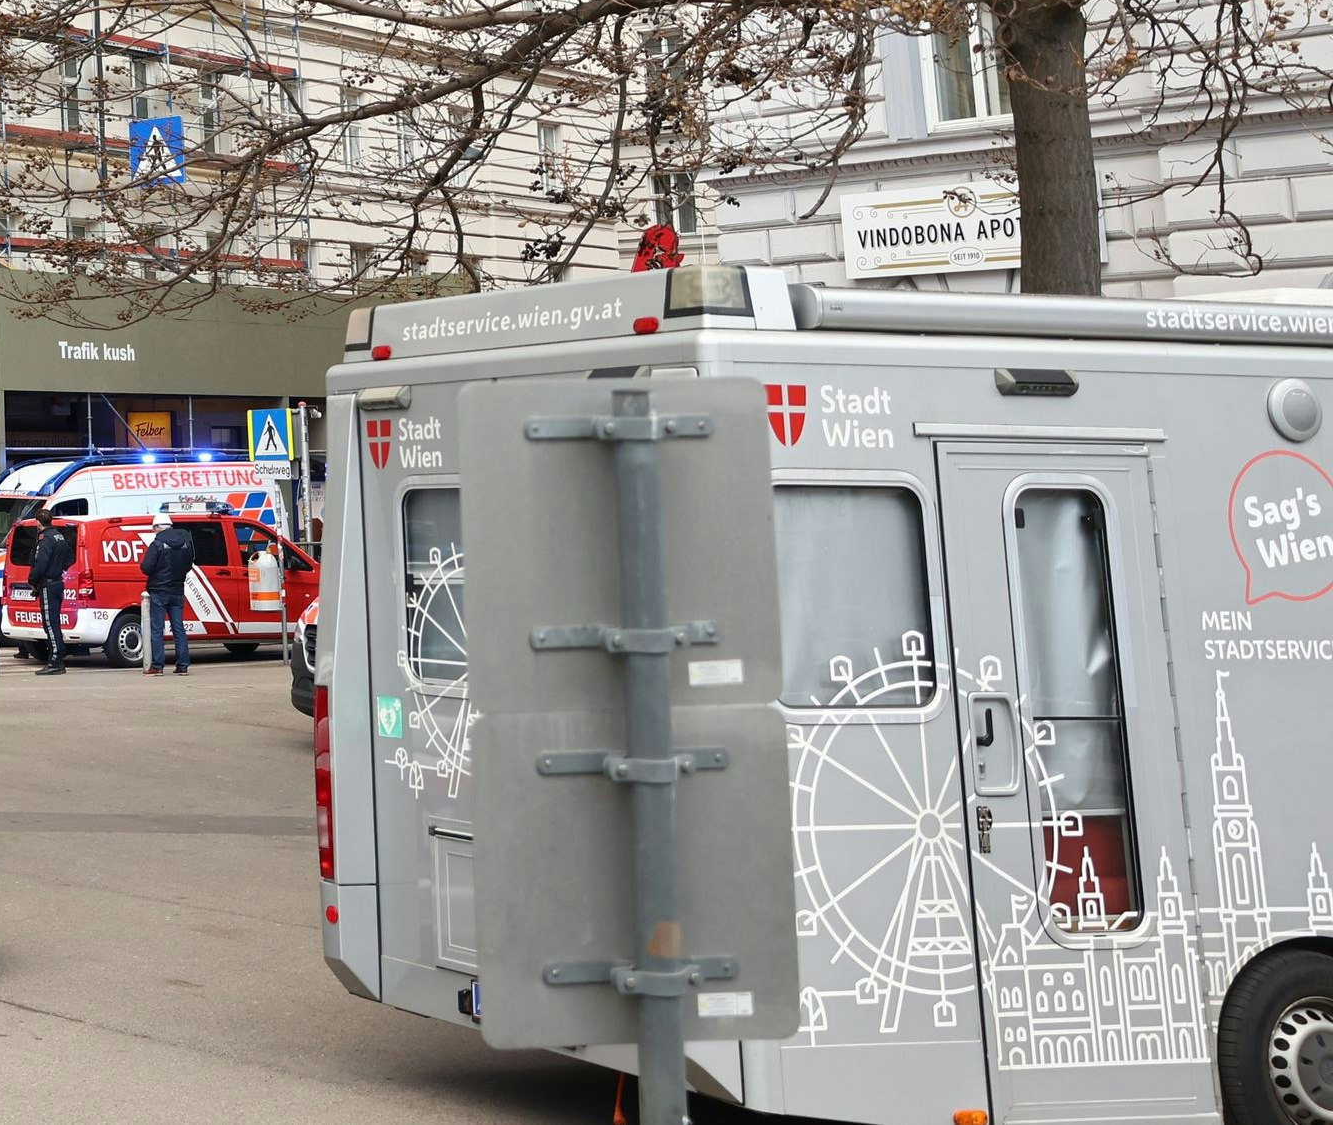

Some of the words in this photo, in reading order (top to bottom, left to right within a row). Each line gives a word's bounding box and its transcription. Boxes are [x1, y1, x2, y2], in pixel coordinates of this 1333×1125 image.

[857, 222, 965, 250] VINDOBONA
[976, 216, 1022, 240] APO
[953, 253, 967, 261] SEIT
[967, 251, 980, 260] 1910
[402, 297, 623, 342] stadtservice.wien.gv.at
[58, 340, 100, 360] Trafik
[103, 342, 136, 362] kush
[820, 384, 891, 415] Stadt
[135, 422, 165, 437] Felber
[398, 415, 442, 442] Stadt
[821, 418, 894, 449] Wien
[399, 444, 443, 469] Wien
[254, 463, 290, 478] Schulweg
[1243, 487, 1322, 531] Sag's
[102, 540, 144, 563] KDF
[1255, 531, 1333, 569] Wien
[92, 610, 109, 621] 126
[1201, 610, 1253, 631] MEIN
[1204, 639, 1333, 660] STADTSERVIC
